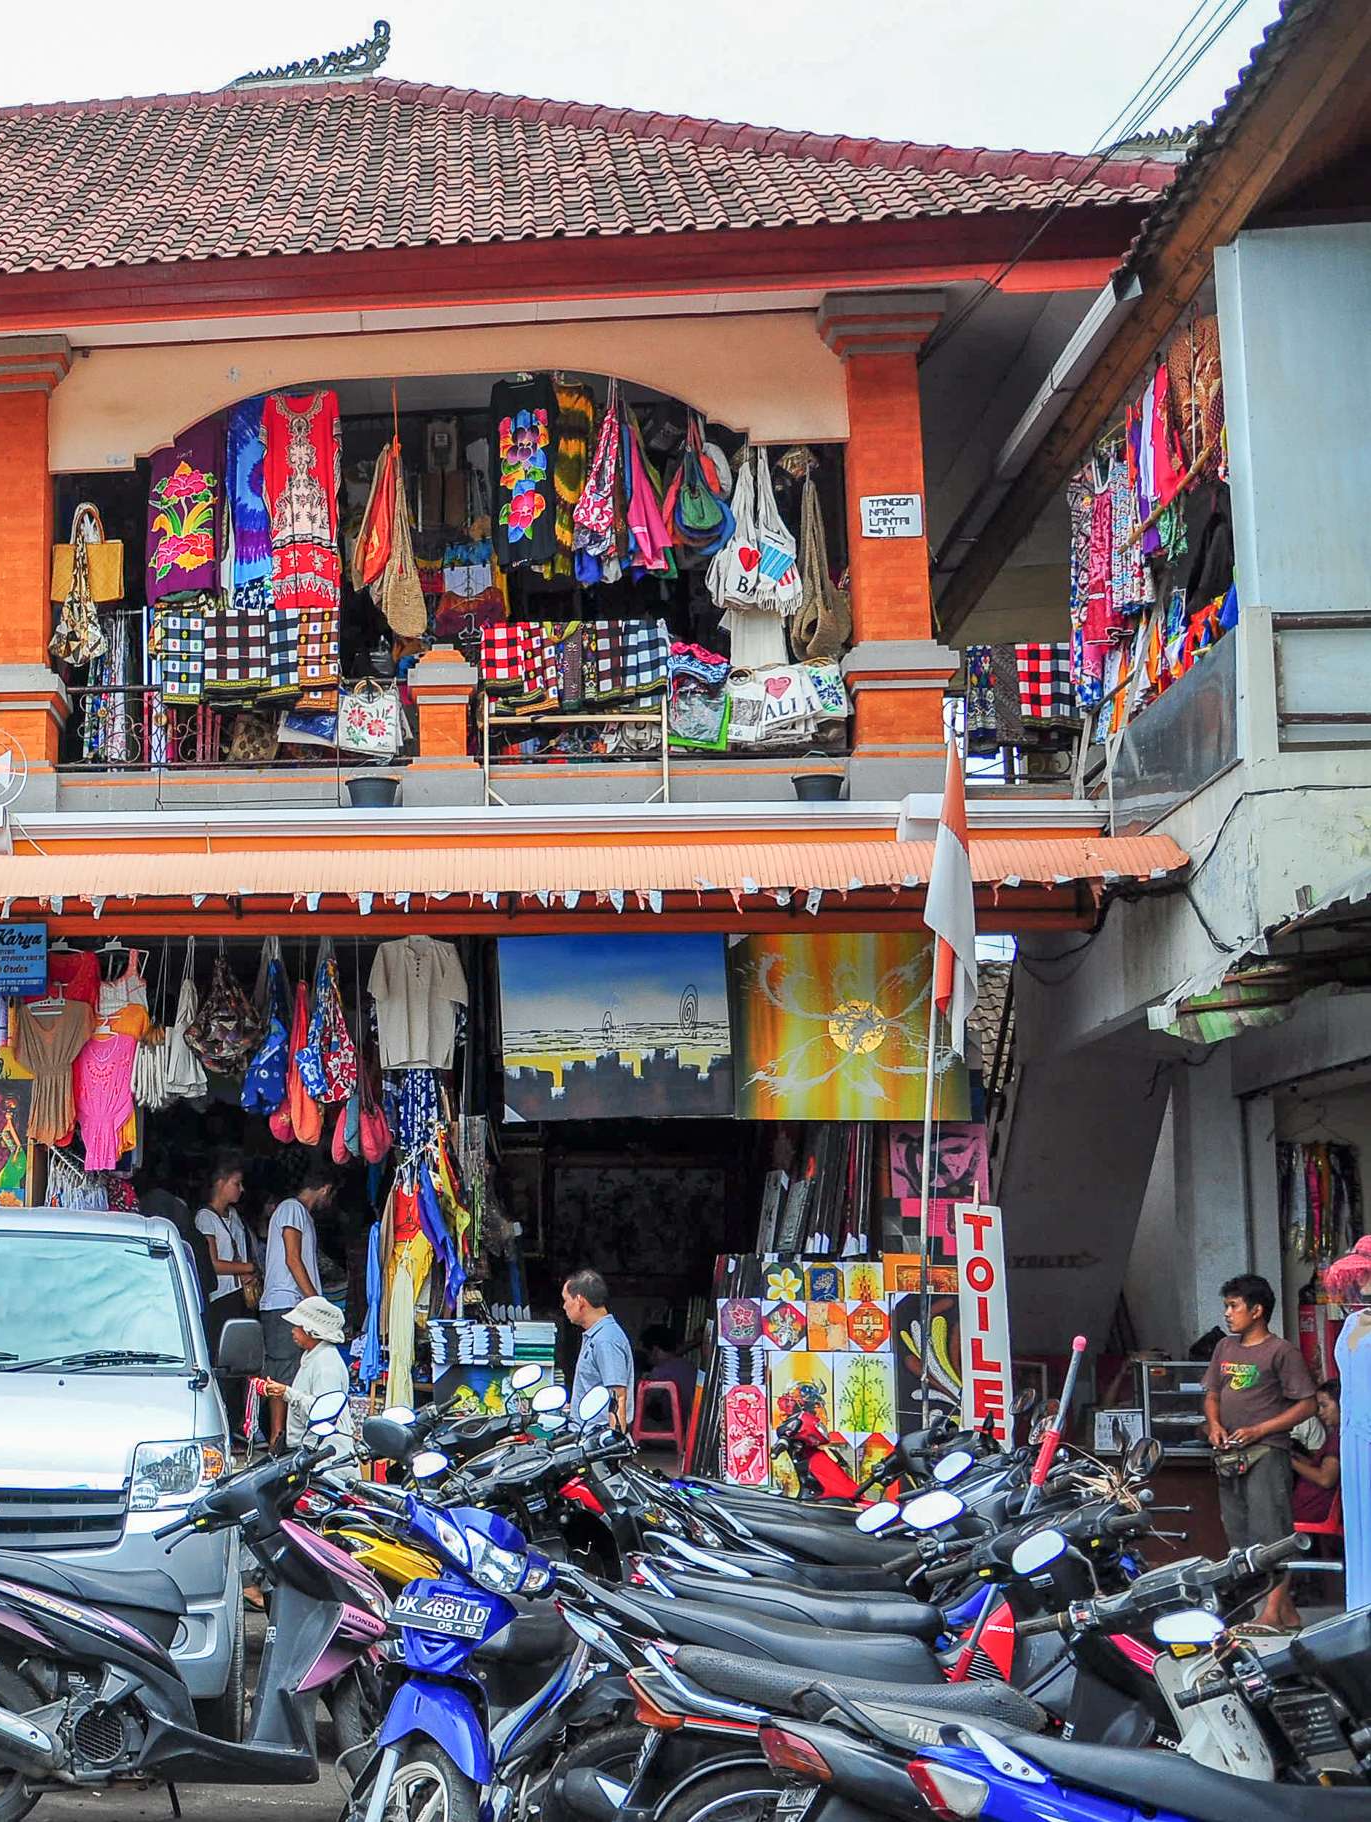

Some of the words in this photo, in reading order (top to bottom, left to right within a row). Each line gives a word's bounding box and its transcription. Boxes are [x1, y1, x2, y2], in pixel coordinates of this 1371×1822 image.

[869, 498, 914, 507] TANGGA
[869, 508, 895, 516] NAIK
[869, 517, 910, 526] LANTAI
[764, 699, 798, 721] ALI
[395, 1597, 419, 1612] DK
[421, 1601, 460, 1620] 4681
[463, 1606, 486, 1622] LD
[348, 1612, 379, 1630] HONDA
[908, 1722, 945, 1746] YAM
